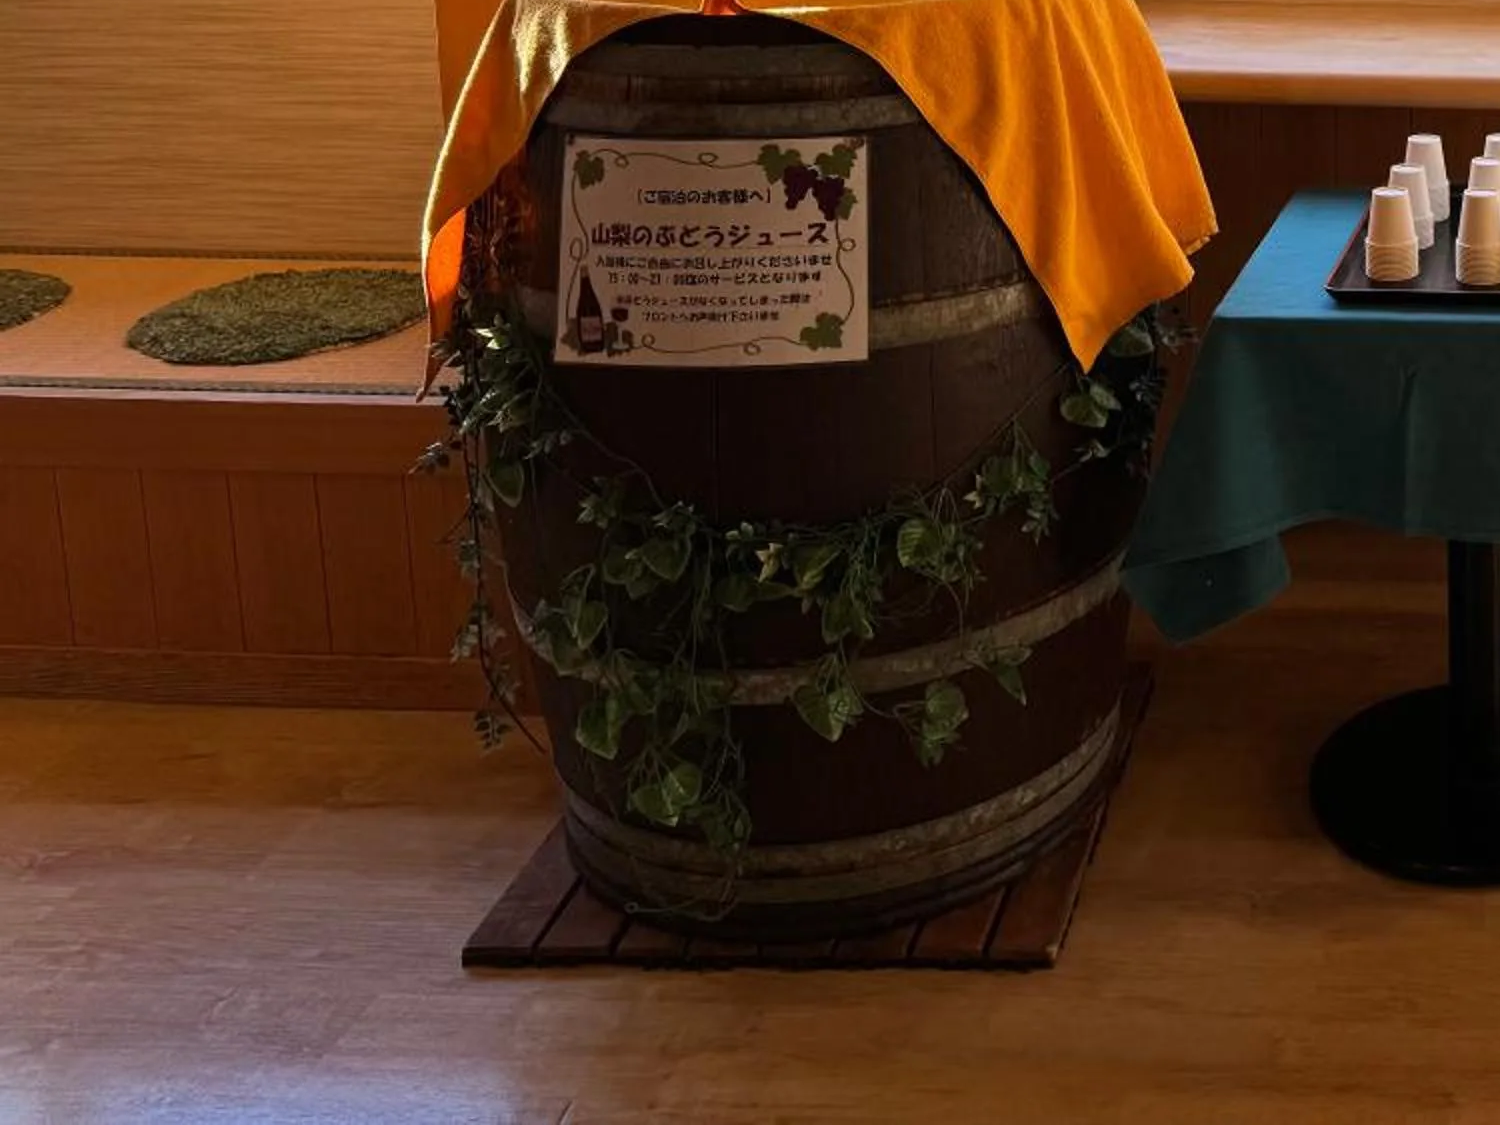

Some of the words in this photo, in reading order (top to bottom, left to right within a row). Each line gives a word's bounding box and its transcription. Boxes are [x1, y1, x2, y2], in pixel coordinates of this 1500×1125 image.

[590, 222, 829, 249] 山梨のぶどうジュース
